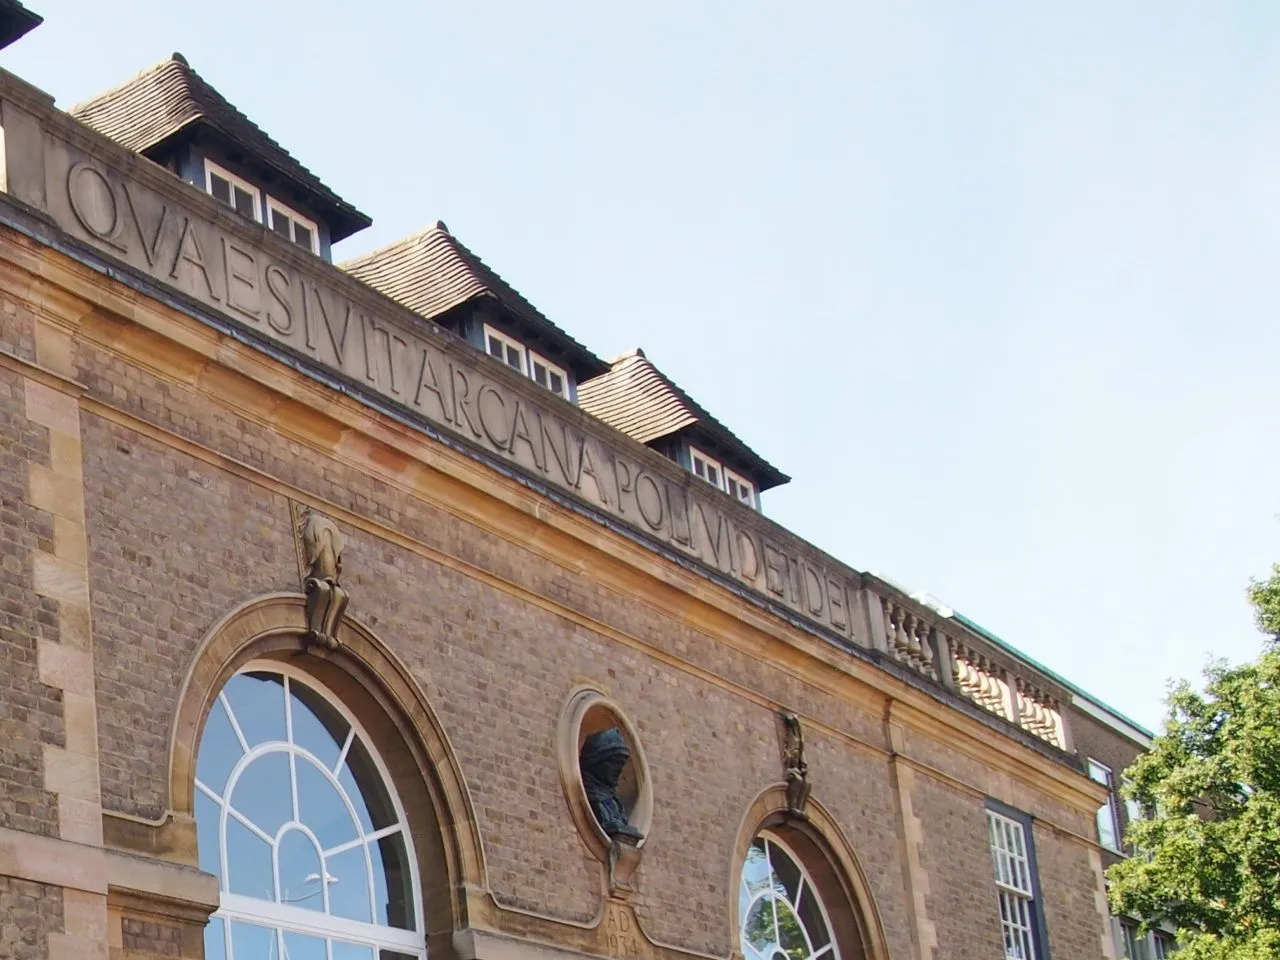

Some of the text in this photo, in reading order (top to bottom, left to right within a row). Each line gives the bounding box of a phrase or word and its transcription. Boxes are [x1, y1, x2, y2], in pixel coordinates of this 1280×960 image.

[414, 348, 608, 505] ARCANA
[609, 453, 696, 551] POLI
[694, 502, 798, 605] VIDET
[800, 560, 857, 638] DEI
[604, 931, 640, 960] 1934
